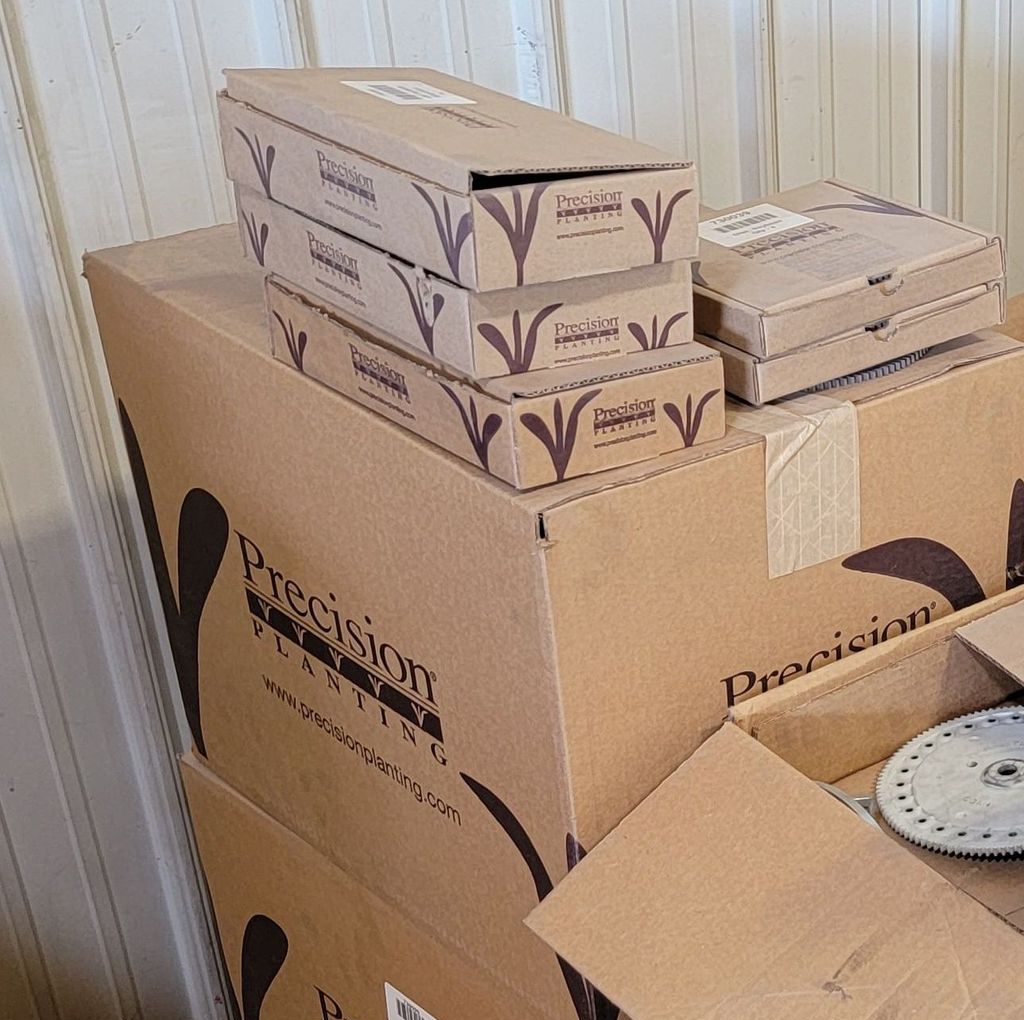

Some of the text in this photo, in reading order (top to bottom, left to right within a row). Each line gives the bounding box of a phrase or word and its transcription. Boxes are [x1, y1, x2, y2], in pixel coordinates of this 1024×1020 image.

[316, 149, 374, 191] Precision
[555, 189, 623, 208] Precision
[555, 316, 619, 335] Precision
[593, 398, 656, 420] Precision
[252, 617, 448, 766] PLANTING
[262, 674, 462, 826] www.precisionplanting.com
